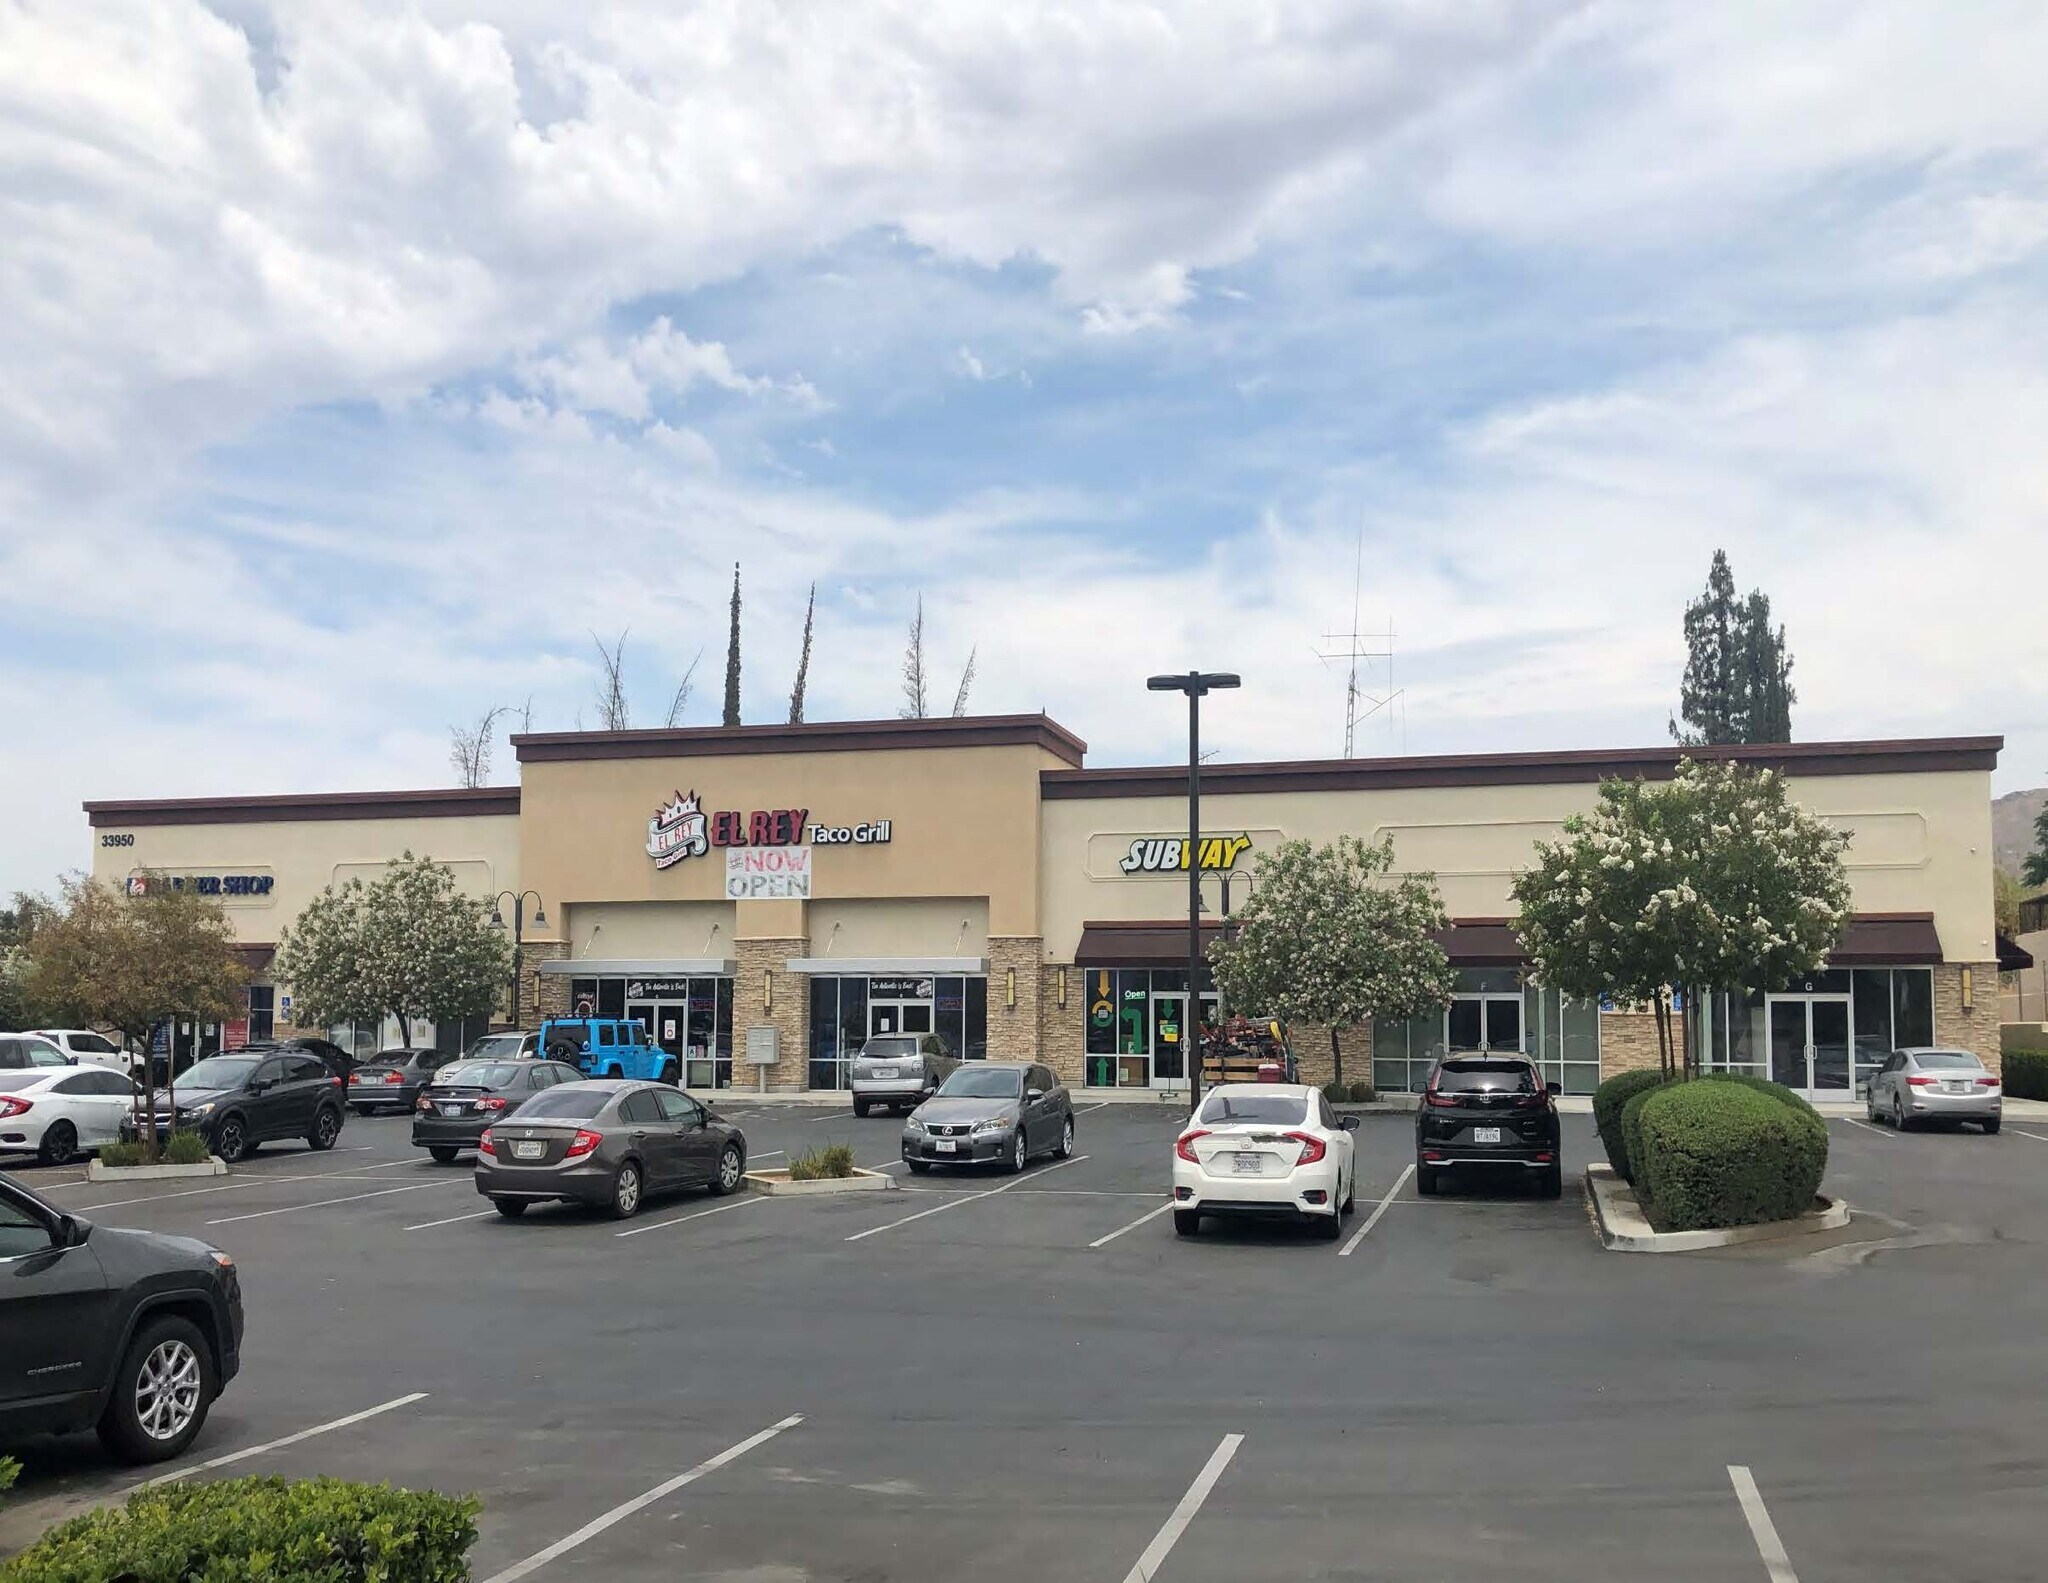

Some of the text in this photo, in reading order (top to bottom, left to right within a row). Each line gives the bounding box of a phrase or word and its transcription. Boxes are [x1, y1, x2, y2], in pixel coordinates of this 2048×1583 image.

[658, 821, 693, 851] EL REY
[711, 809, 892, 847] EL REY Taco Grill
[101, 834, 135, 847] 33950
[744, 849, 809, 872] NOW
[1119, 831, 1253, 876] SUBWAY
[222, 875, 275, 895] SHOP
[728, 874, 809, 897] OPEN
[1124, 989, 1146, 999] Open
[1183, 982, 1189, 990] E
[1481, 982, 1488, 991] F
[1805, 982, 1813, 991] G
